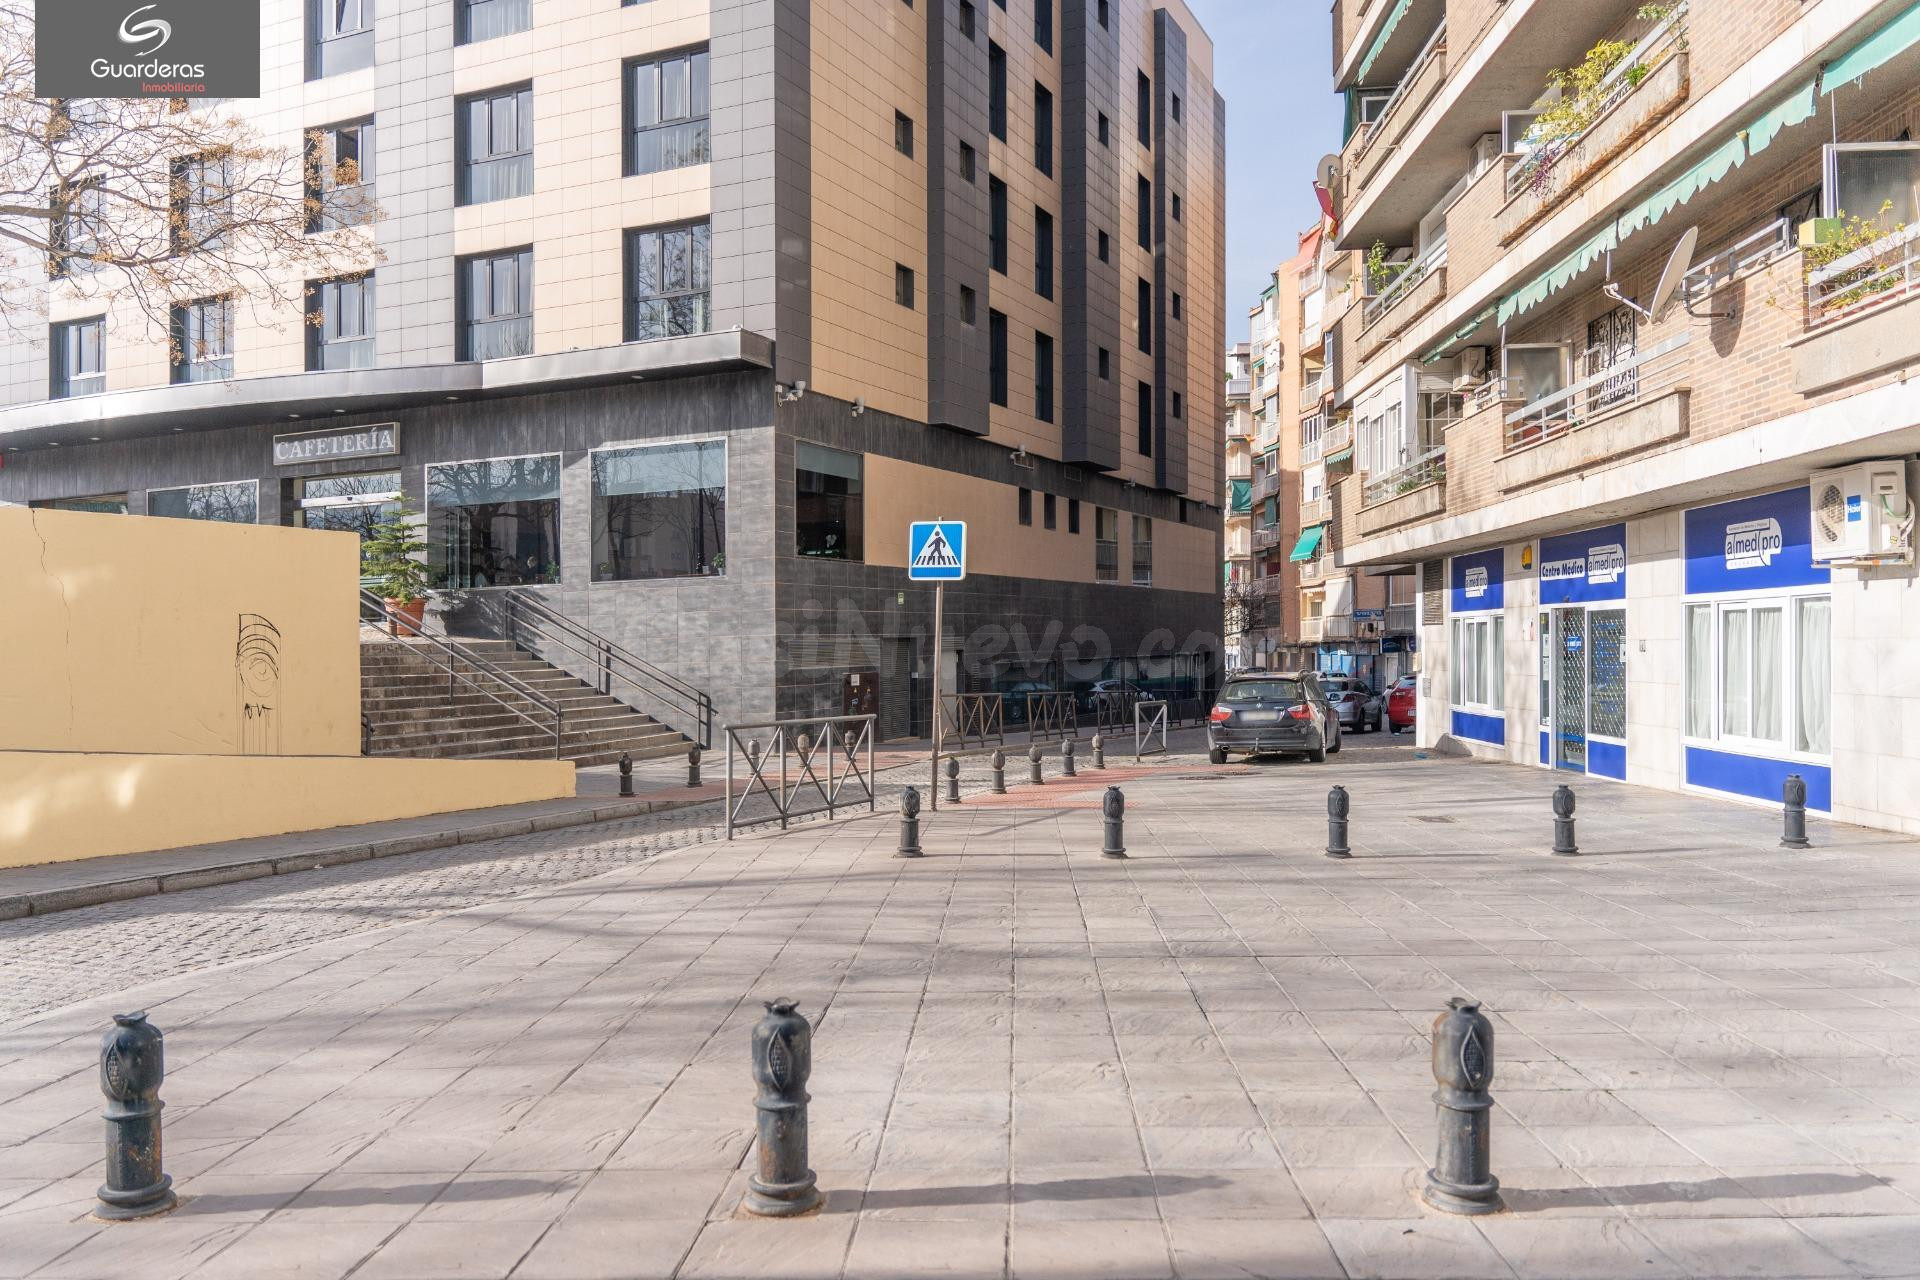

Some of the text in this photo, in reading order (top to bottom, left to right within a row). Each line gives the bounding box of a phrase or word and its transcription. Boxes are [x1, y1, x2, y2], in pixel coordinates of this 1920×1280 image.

[276, 426, 395, 460] CAFETERÍA
[1542, 560, 1584, 578] Centro Médico
